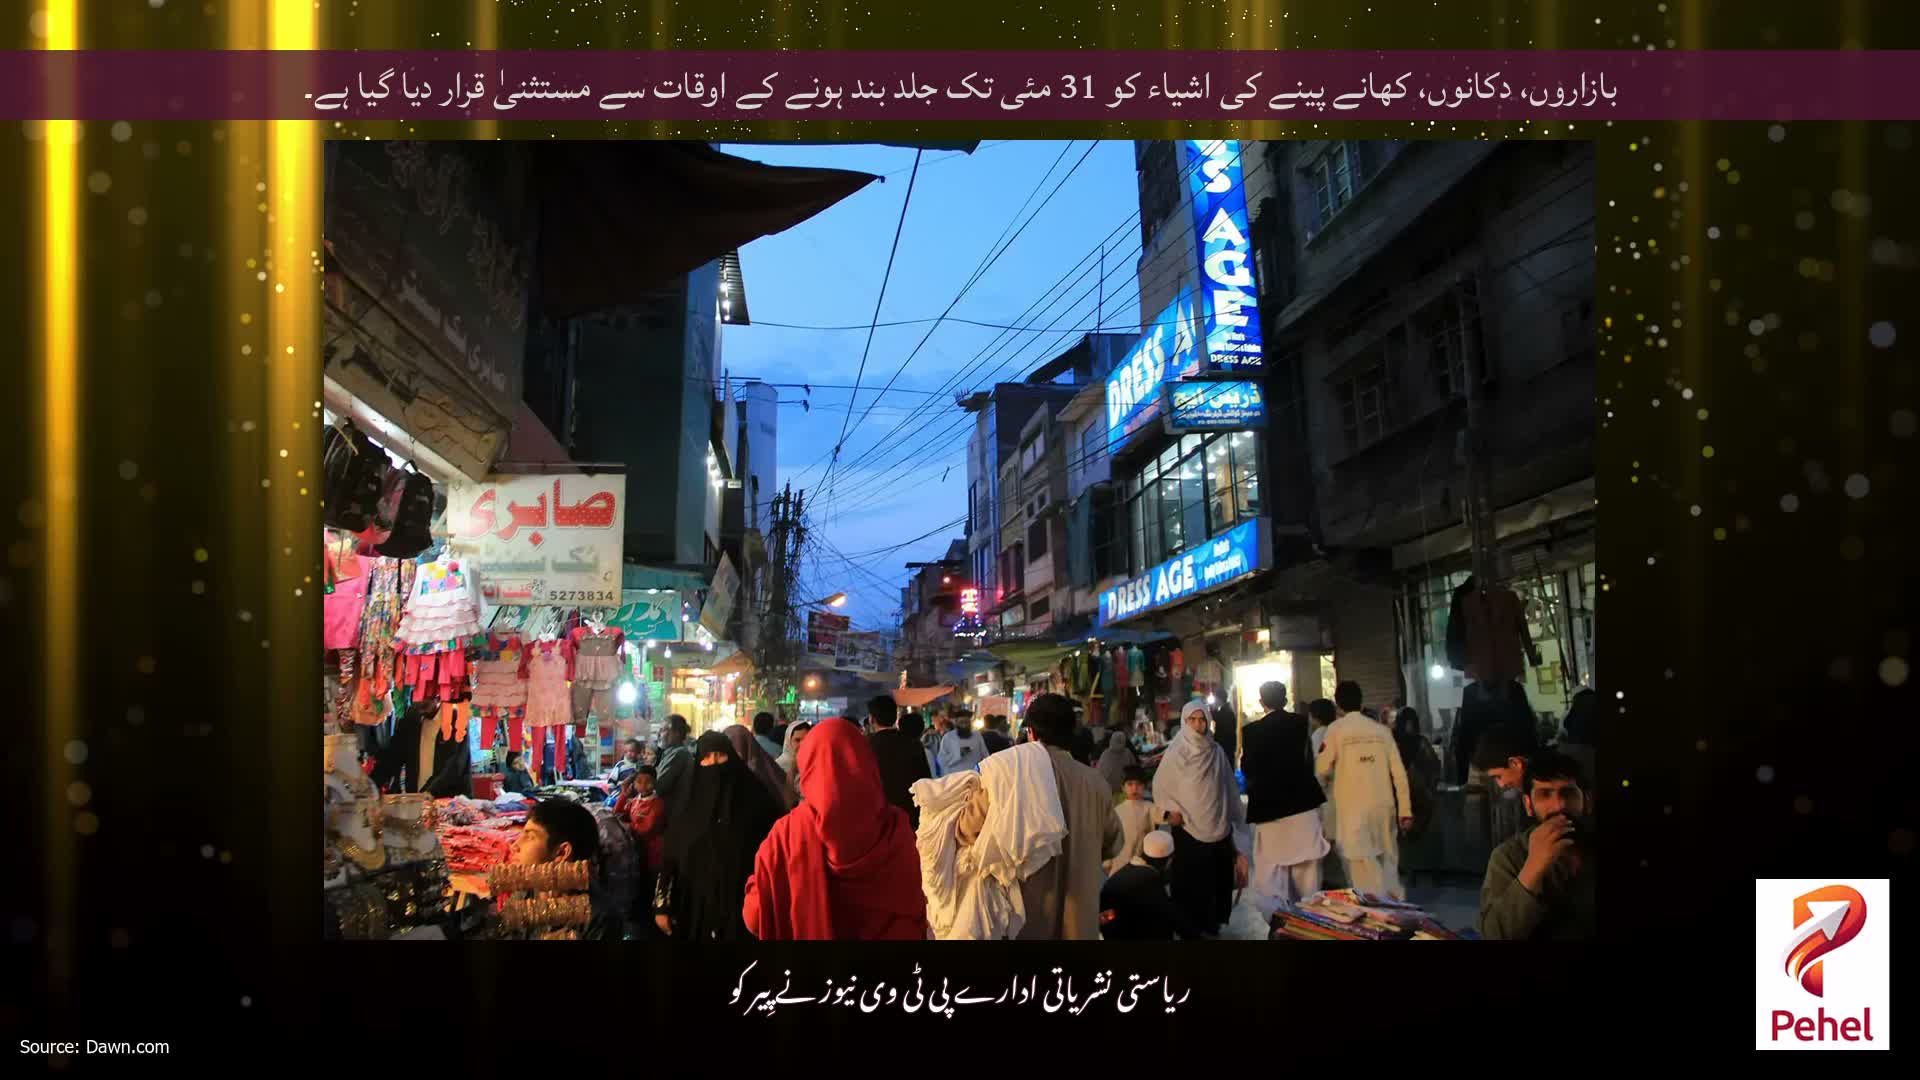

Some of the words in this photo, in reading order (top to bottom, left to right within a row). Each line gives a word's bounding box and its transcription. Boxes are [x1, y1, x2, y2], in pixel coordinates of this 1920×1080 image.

[1202, 207, 1251, 327] AGE
[1108, 323, 1165, 430] DRESS
[1210, 353, 1239, 364] DRESS
[459, 478, 617, 546] صابری
[549, 590, 614, 601] 5273834
[1107, 573, 1151, 620] DRESS
[1155, 554, 1194, 602] AGE
